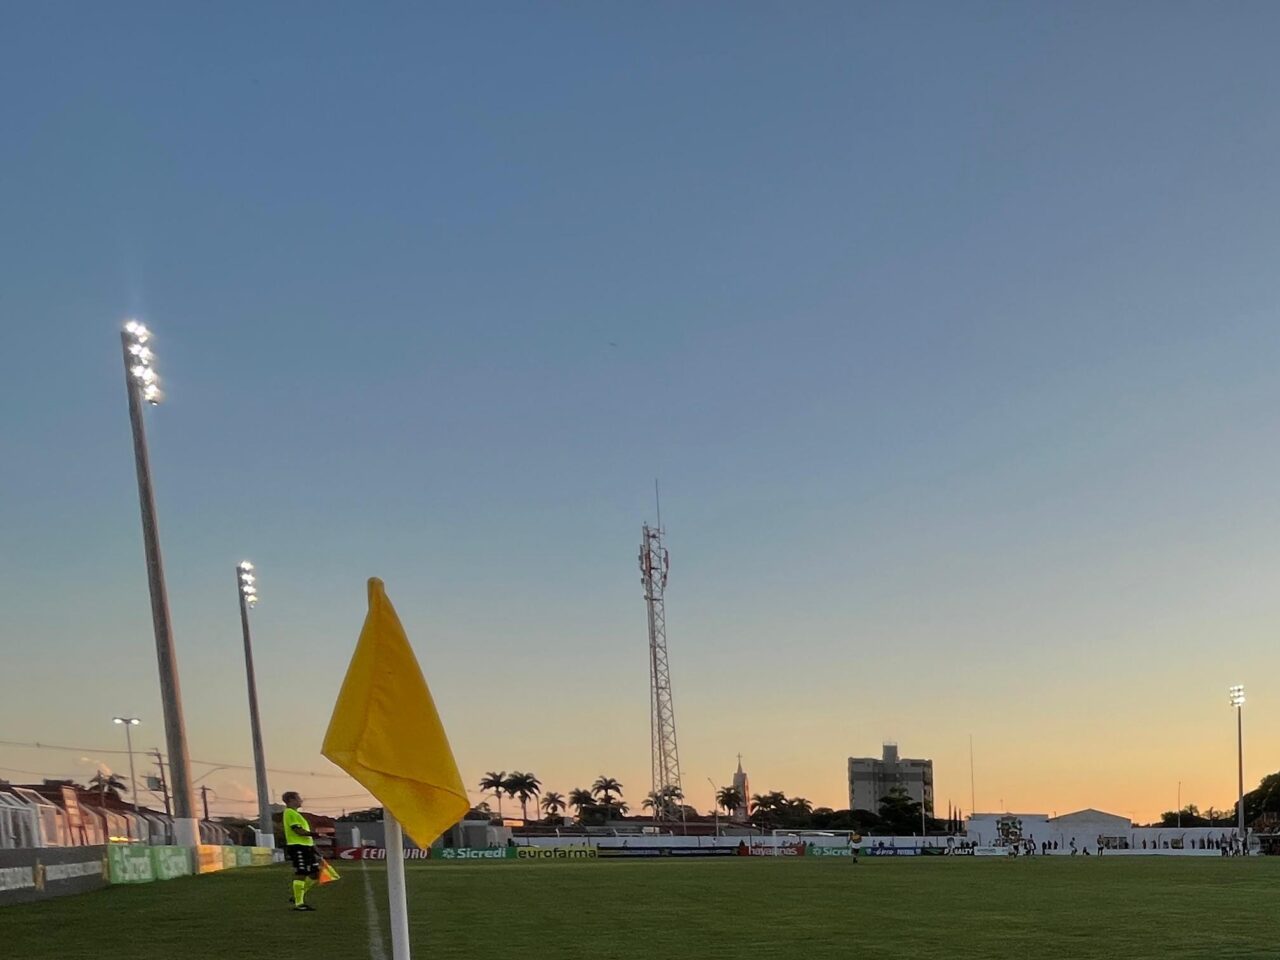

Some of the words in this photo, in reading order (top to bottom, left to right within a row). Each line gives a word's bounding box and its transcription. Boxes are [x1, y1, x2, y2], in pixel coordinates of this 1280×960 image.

[362, 848, 428, 859] CENURO
[456, 847, 506, 859] Sicredi
[518, 848, 597, 859] eurofarma
